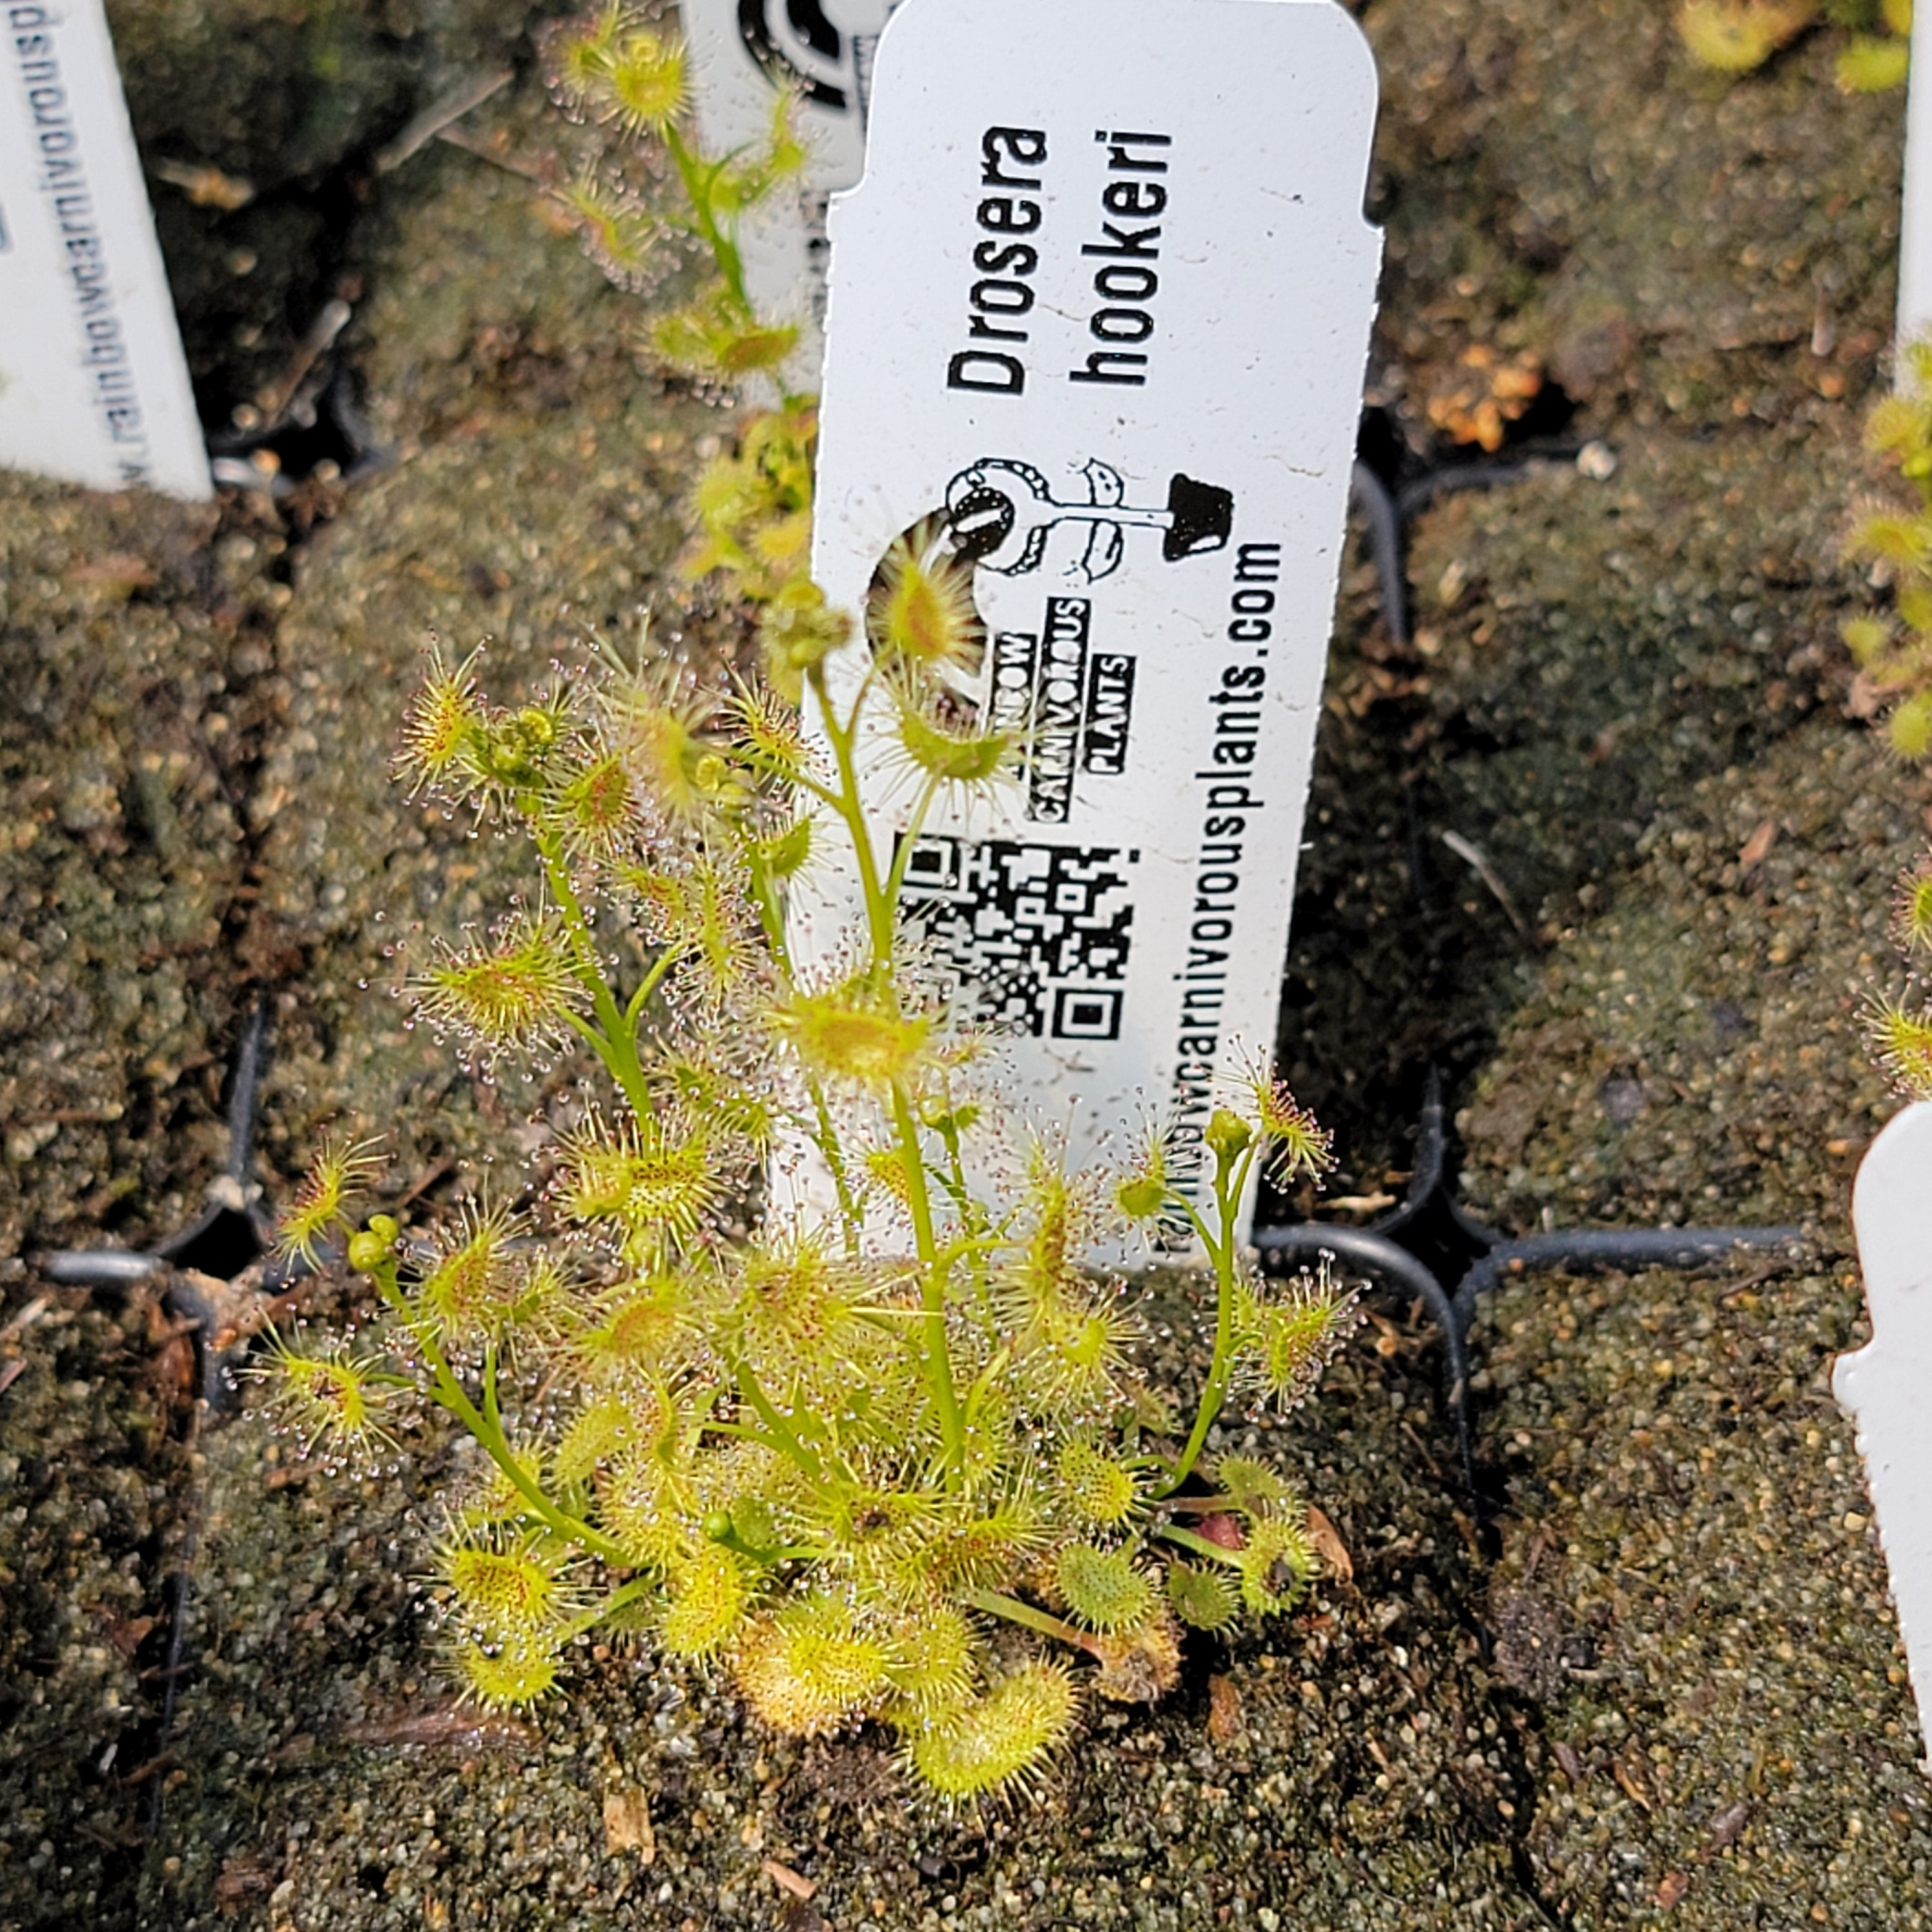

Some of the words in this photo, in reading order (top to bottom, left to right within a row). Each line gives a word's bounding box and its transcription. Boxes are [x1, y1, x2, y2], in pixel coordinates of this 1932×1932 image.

[947, 127, 1047, 396] Drosera
[1069, 130, 1171, 385] hookeri
[1091, 657, 1128, 773] PLANTS
